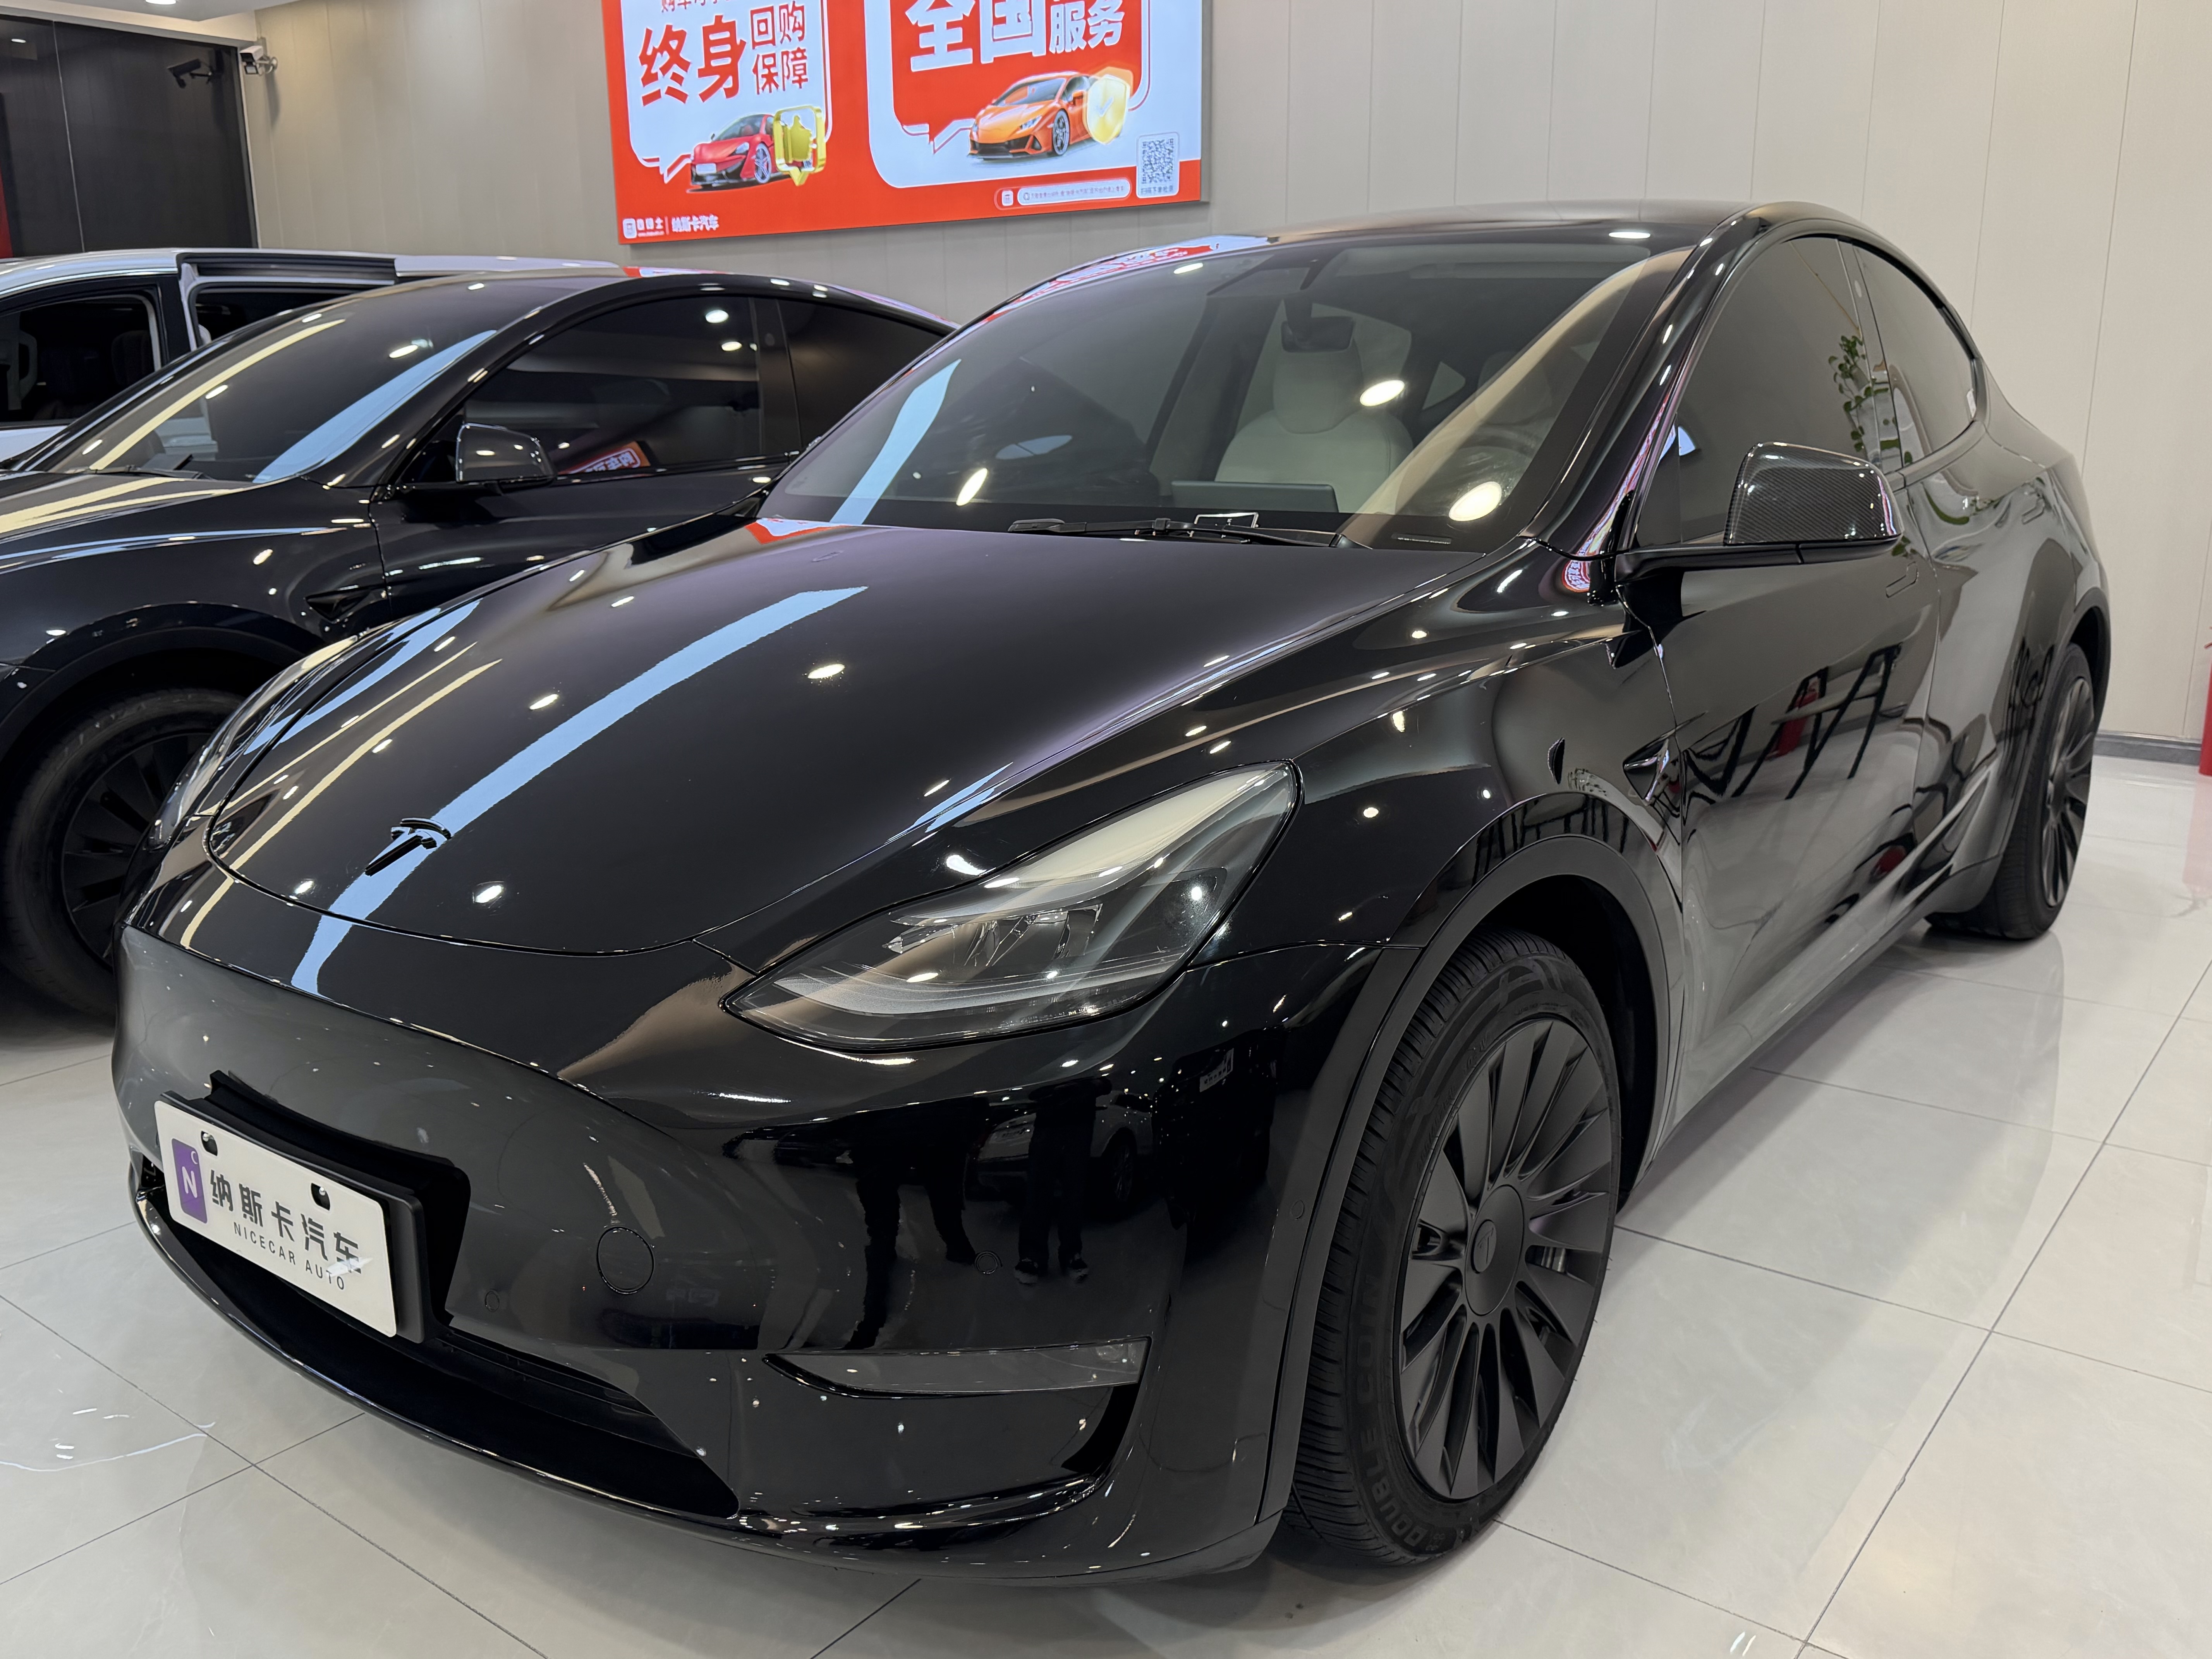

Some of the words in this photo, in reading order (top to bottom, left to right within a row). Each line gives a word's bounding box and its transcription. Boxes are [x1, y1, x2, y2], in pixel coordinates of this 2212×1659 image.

[750, 1, 805, 50] 回购
[905, 0, 1046, 72] 全国
[1049, 0, 1125, 54] 服务
[639, 15, 747, 107] 终身
[752, 47, 809, 95] 保障
[210, 1169, 362, 1274] 纳斯卡汽车
[233, 1221, 296, 1265] NICECAR
[305, 1259, 344, 1290] AUTO
[1360, 1426, 1428, 1548] DOUBLE
